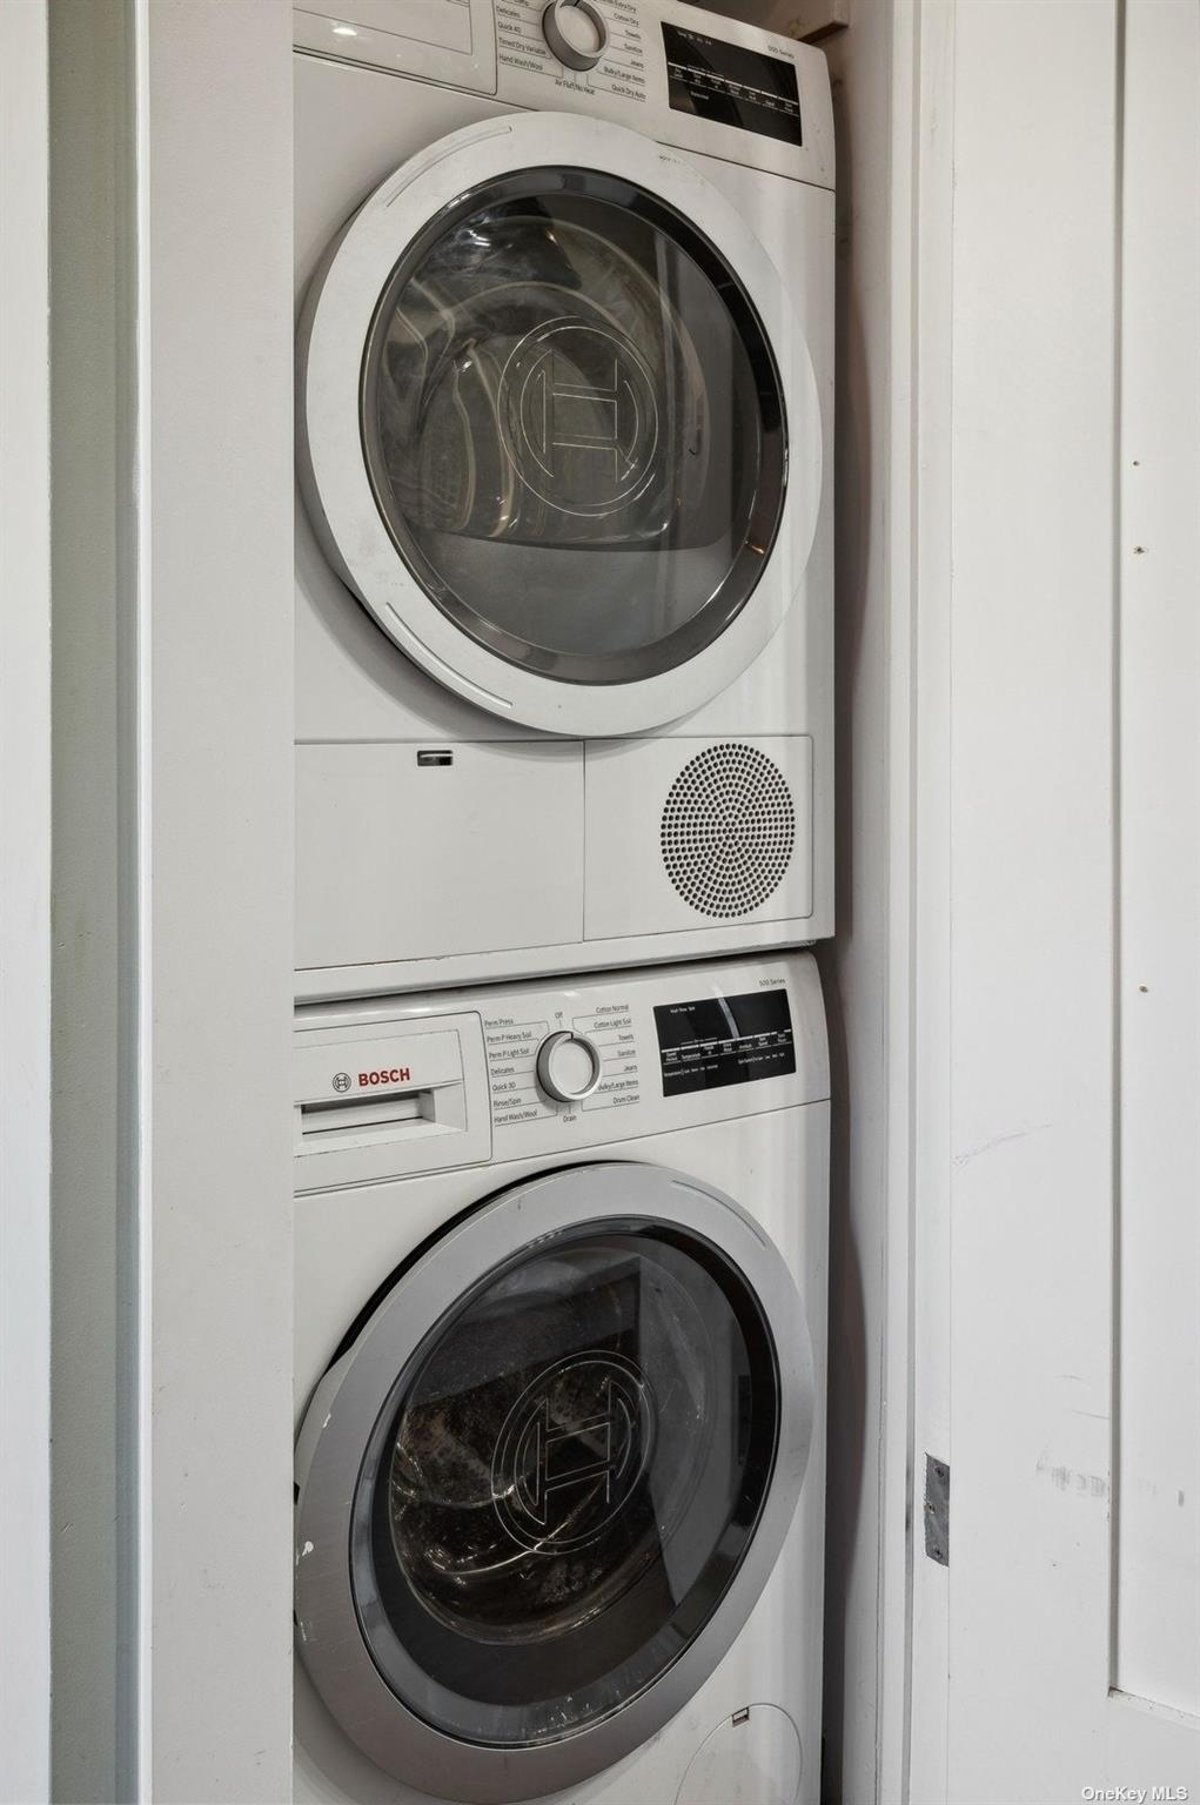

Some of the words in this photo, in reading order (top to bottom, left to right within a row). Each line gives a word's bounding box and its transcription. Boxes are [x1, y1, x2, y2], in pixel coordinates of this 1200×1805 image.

[498, 21, 512, 32] Quick
[499, 37, 515, 48] Timed
[515, 40, 525, 51] Dry
[525, 43, 546, 55] Variable
[499, 54, 513, 64] Hand
[514, 56, 543, 71] Wash/Wool
[604, 66, 632, 81] Bulky/Large
[612, 84, 627, 94] Quick
[626, 87, 634, 97] Dry
[635, 90, 646, 99] Auto
[610, 1020, 621, 1028] Light
[506, 1033, 522, 1041] Heavy
[507, 1049, 520, 1057] Light
[491, 1067, 515, 1075] Delicates
[358, 1068, 410, 1086] BOSCH
[492, 1083, 508, 1091] Quick
[493, 1098, 522, 1107] Rinse/Spin
[626, 1094, 640, 1102] Clean
[509, 1110, 537, 1121] Wash/Wool
